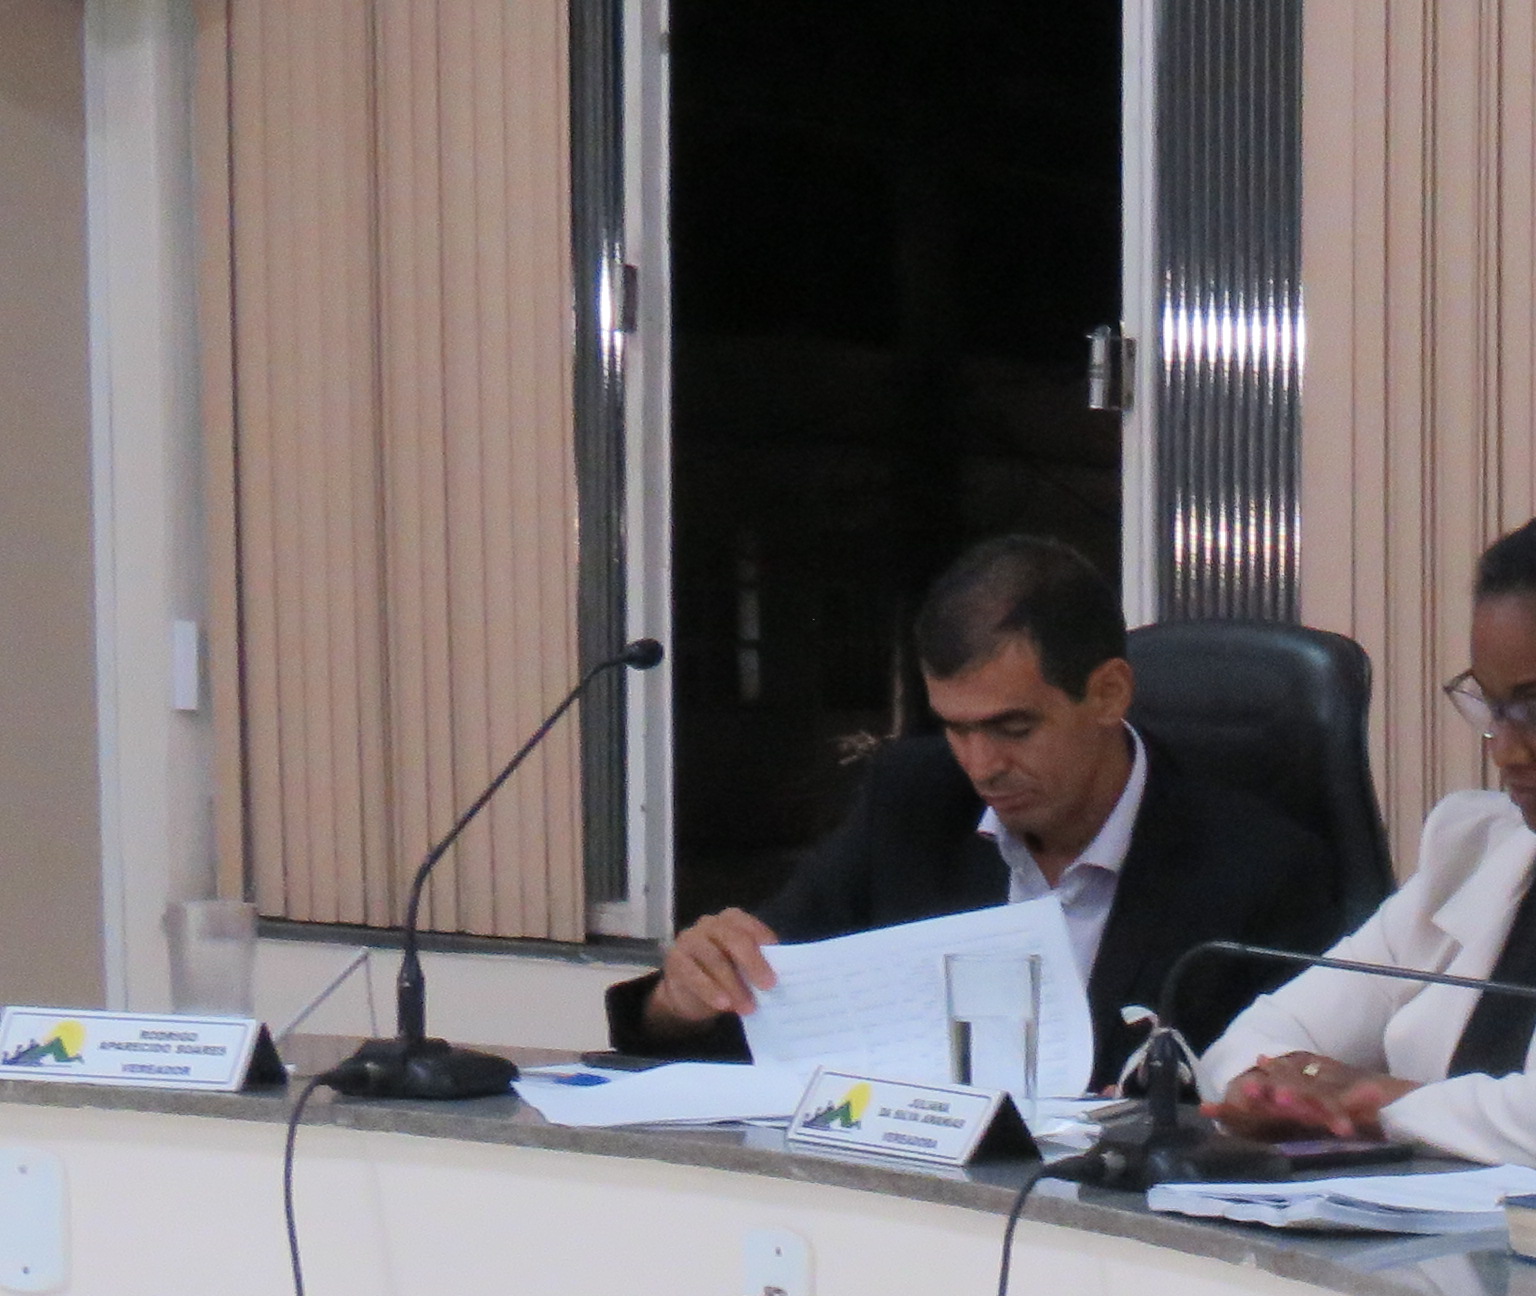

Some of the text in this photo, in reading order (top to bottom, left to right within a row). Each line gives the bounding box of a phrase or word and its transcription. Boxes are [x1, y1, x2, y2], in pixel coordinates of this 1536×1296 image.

[99, 1041, 227, 1056] APARECIDO SOARES
[122, 1063, 191, 1076] VEREADOR
[883, 1132, 938, 1148] VEREADORA
